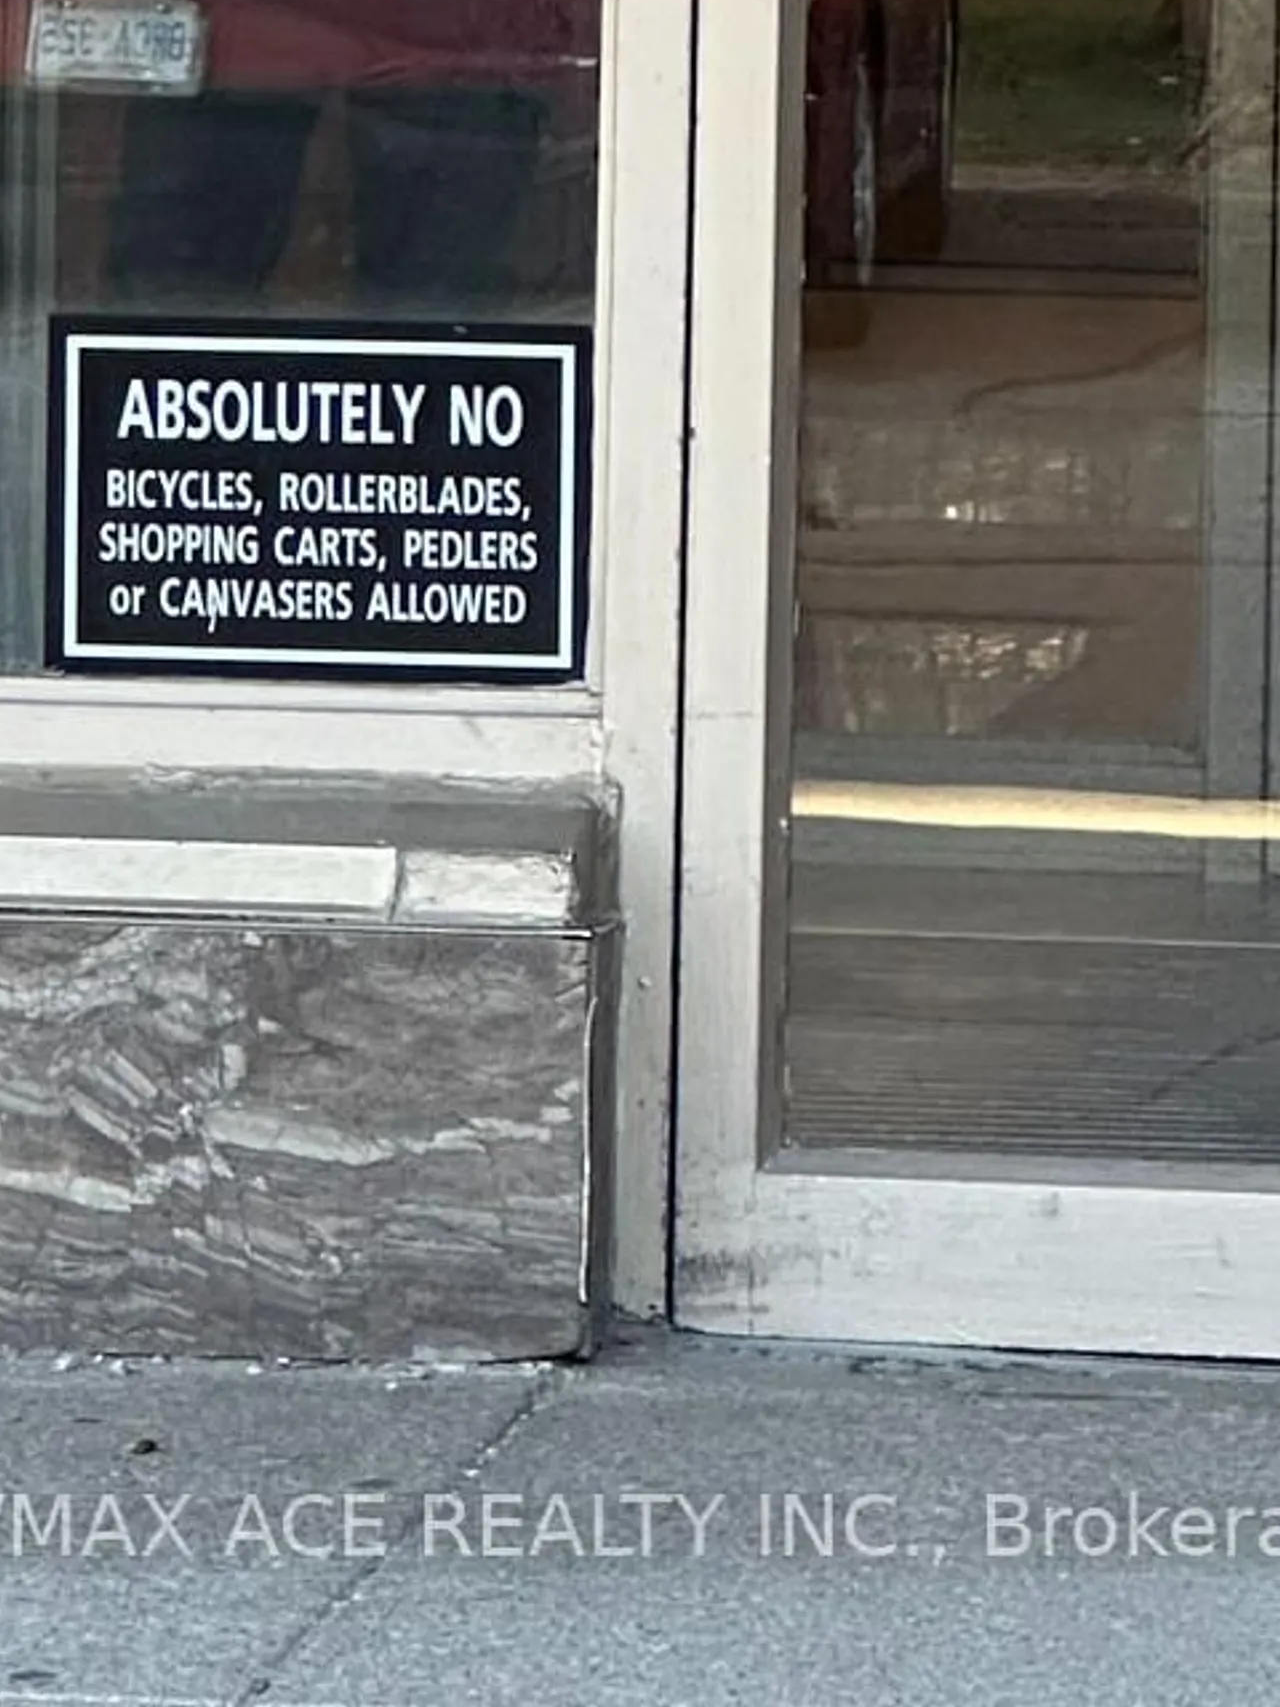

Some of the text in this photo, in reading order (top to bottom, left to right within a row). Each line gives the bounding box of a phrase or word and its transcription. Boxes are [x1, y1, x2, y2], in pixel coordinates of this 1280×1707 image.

[117, 378, 524, 448] ABSOLUTELY NO
[106, 469, 532, 521] BICYCLES, ROLLERBLADES,
[98, 522, 539, 572] SHOPPING CARTS, PEDLERS
[109, 577, 528, 624] or CANVASERS ALLOWED
